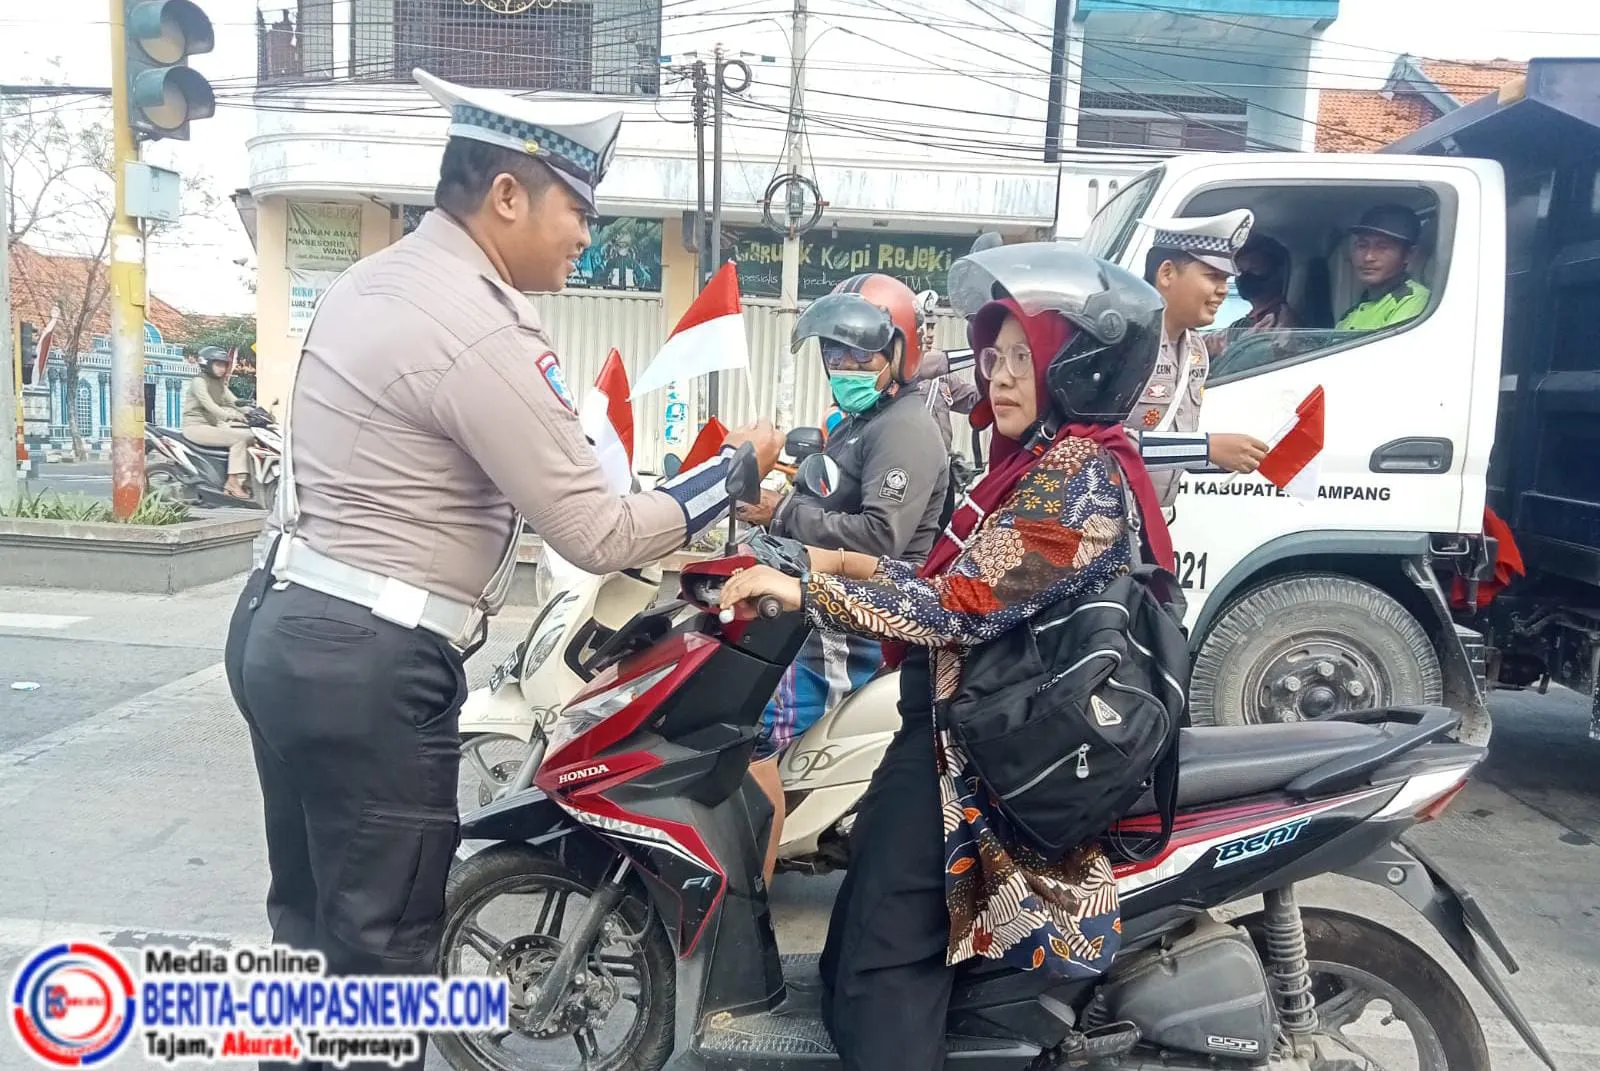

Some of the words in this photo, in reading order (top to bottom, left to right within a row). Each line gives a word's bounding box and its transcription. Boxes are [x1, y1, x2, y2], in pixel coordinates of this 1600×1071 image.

[1195, 482, 1291, 498] KABUPATE
[1317, 485, 1391, 501] AMPANG
[559, 763, 610, 784] HONDA
